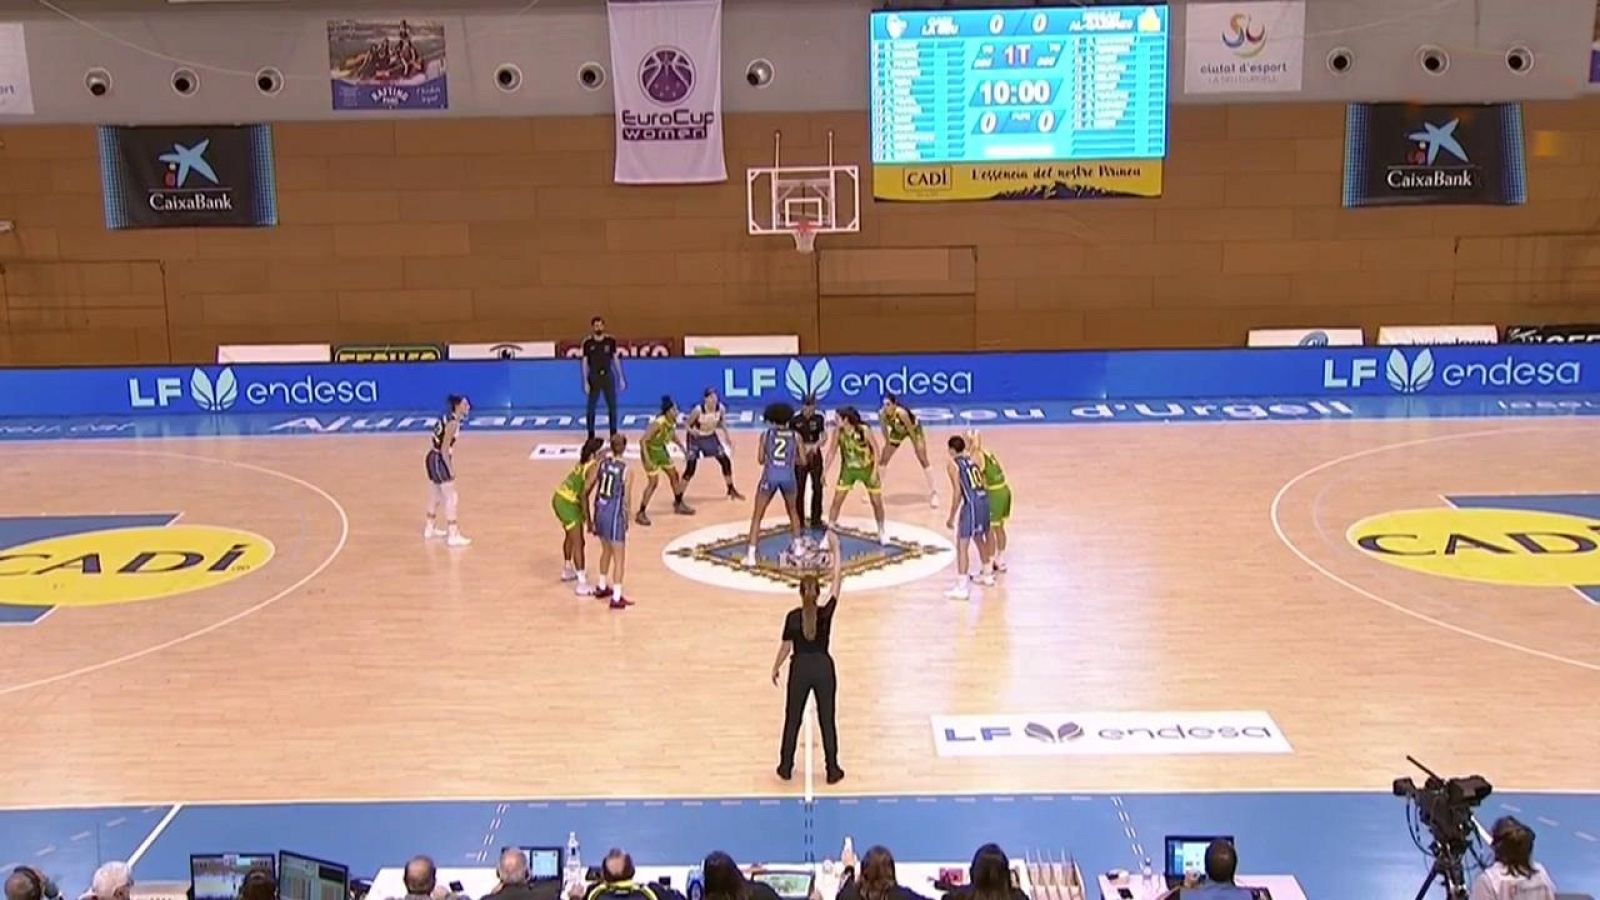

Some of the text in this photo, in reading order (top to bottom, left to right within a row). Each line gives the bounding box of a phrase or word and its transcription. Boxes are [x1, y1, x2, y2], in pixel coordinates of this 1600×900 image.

[990, 14, 1004, 34] 0
[1032, 12, 1048, 33] 0
[1004, 44, 1031, 66] 1T
[1200, 62, 1287, 75] ciutat d'esport
[980, 80, 1051, 105] 10:00
[622, 109, 714, 126] EuroCup
[980, 111, 996, 134] 0
[1038, 109, 1055, 133] 0
[624, 127, 707, 140] women
[1033, 166, 1052, 178] del
[1387, 169, 1472, 187] CaixaBank
[149, 193, 232, 211] CaixaBank
[724, 366, 972, 396] LF endesa
[1323, 356, 1581, 387] LF endesa
[128, 375, 378, 407] LF endesa
[267, 415, 691, 432] Ajunamen
[1070, 400, 1354, 419] d'Urgell
[773, 438, 786, 458] 2
[600, 472, 614, 497] 11
[966, 466, 982, 490] 10
[1358, 526, 1600, 556] CAD
[944, 724, 1271, 741] LF endesa
